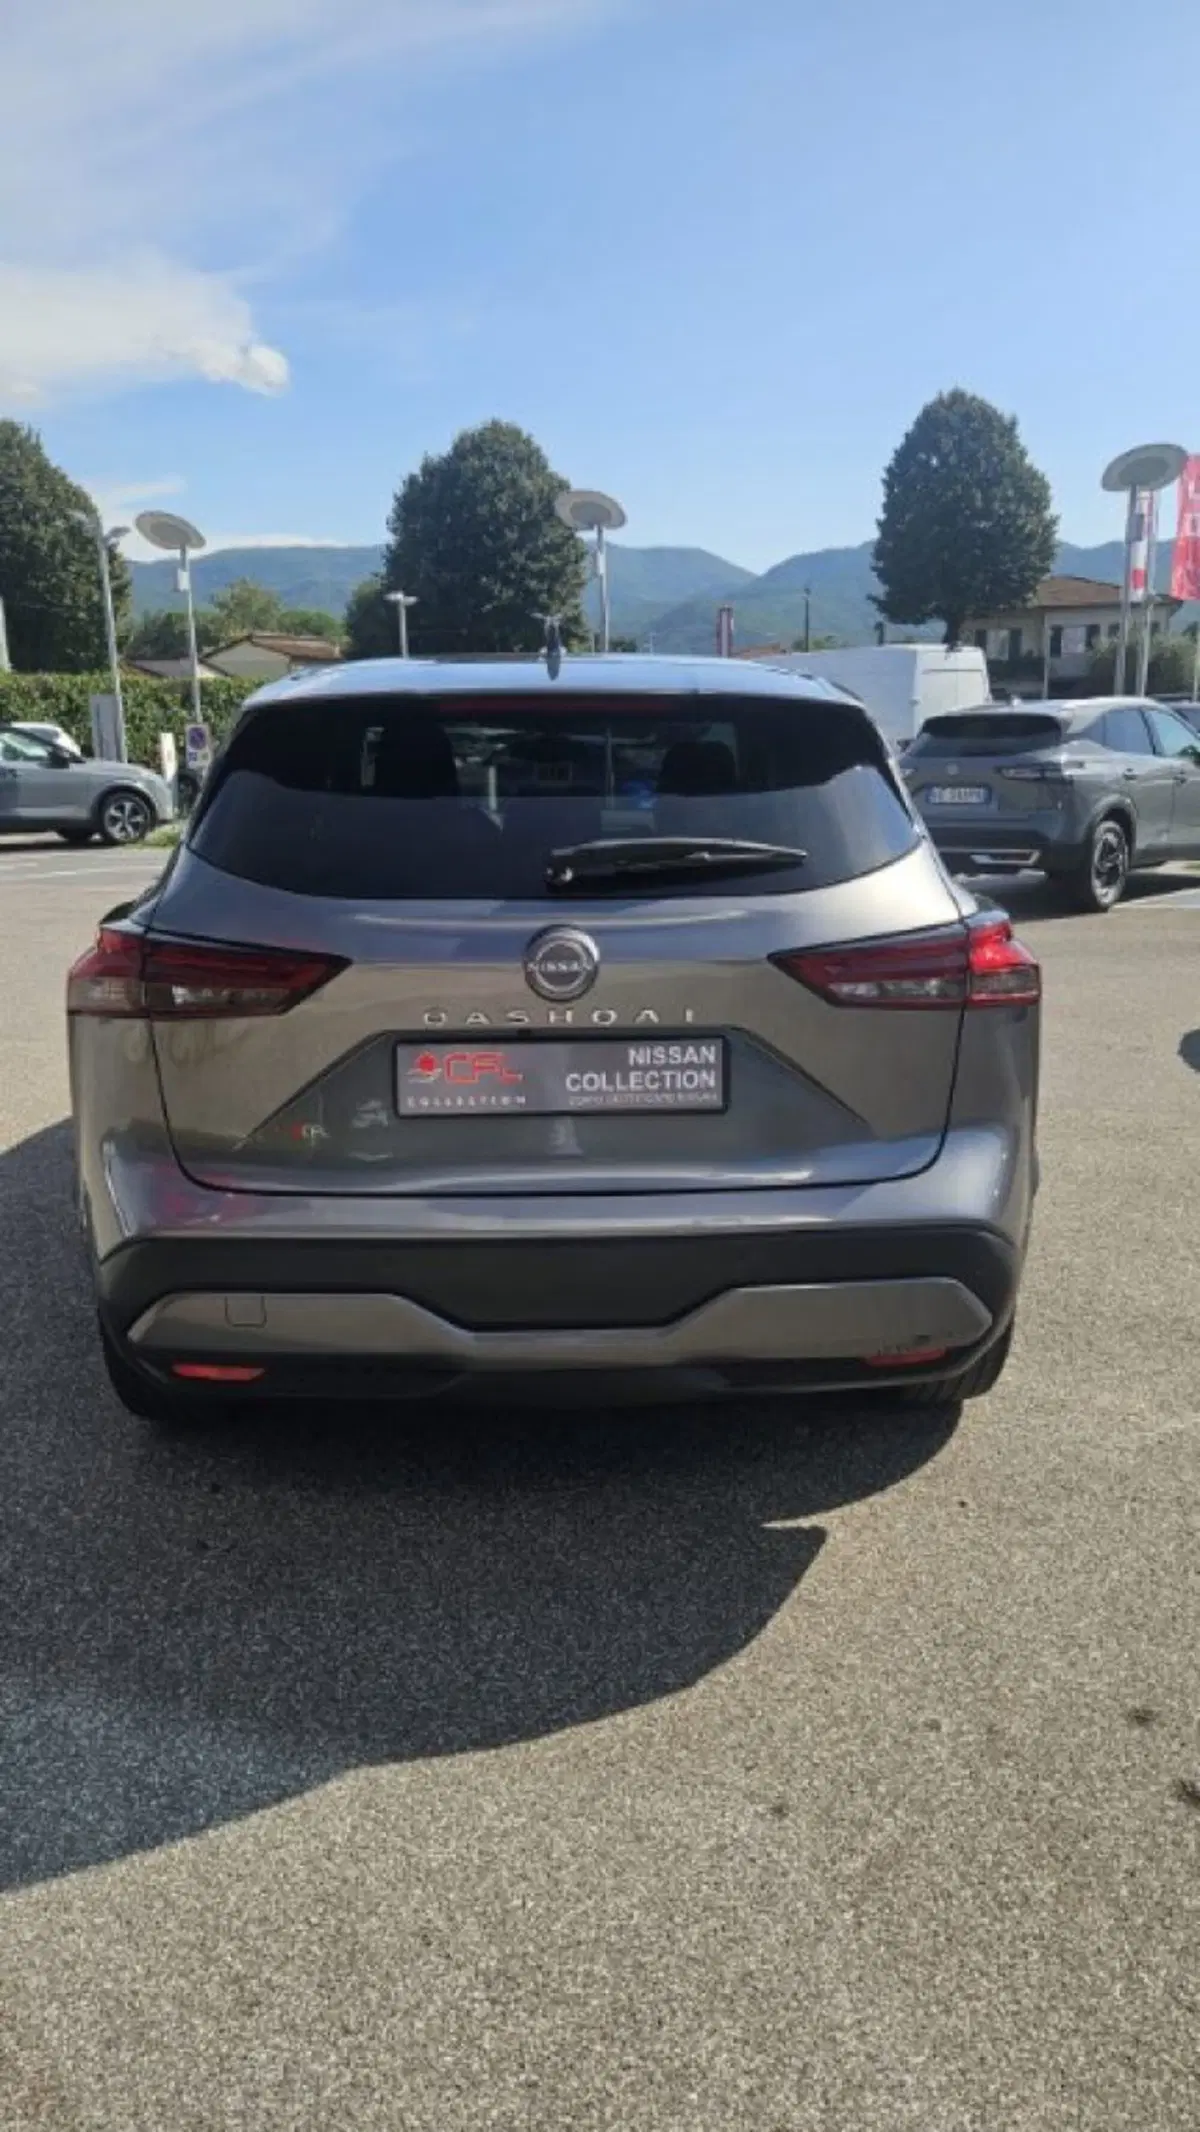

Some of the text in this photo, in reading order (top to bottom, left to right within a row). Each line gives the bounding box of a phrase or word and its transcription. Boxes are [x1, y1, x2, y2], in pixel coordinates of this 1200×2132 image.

[527, 961, 591, 973] NISSAN
[628, 1045, 716, 1067] NISSAN
[565, 1069, 716, 1092] COLLECTION
